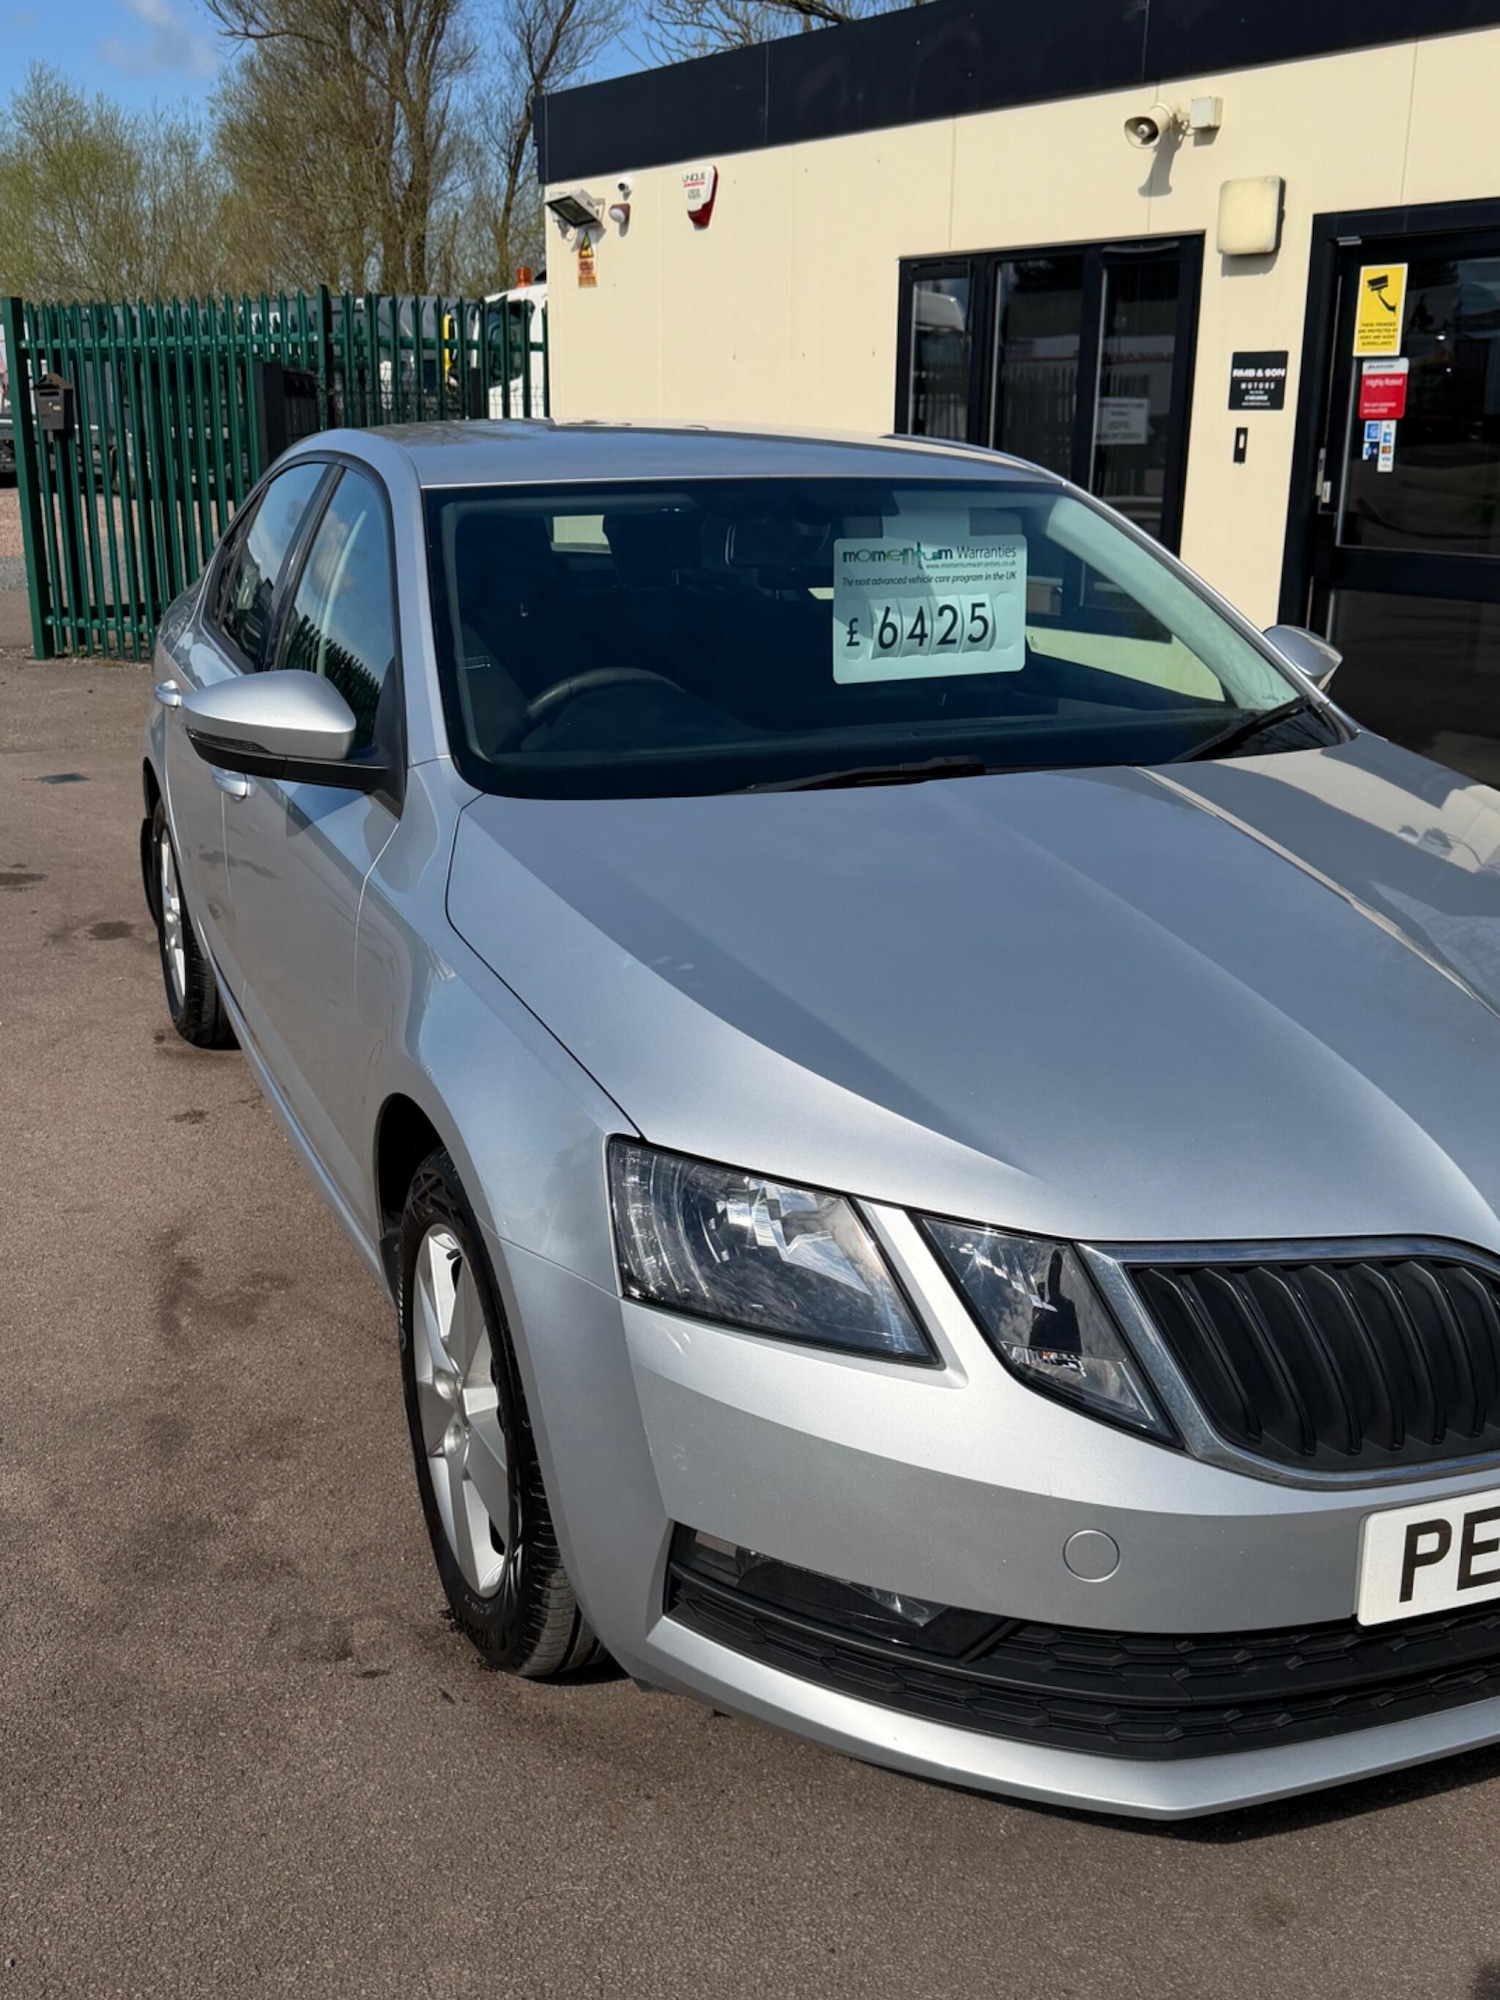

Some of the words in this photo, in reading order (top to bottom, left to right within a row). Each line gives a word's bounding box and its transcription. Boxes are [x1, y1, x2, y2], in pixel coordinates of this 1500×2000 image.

[1232, 368, 1256, 377] RMB
[1264, 368, 1286, 377] SON
[1240, 382, 1276, 390] MOTORS
[842, 542, 953, 570] momentum
[956, 545, 1017, 560] Warranties
[842, 577, 853, 586] The
[854, 577, 870, 586] most
[871, 575, 906, 585] advanced
[908, 574, 933, 584] vehicle
[934, 575, 950, 583] care
[951, 573, 984, 585] program
[985, 571, 992, 581] in
[993, 571, 1004, 581] the
[1005, 570, 1017, 580] UK
[878, 602, 990, 650] 6425
[1399, 1506, 1500, 1603] PE
